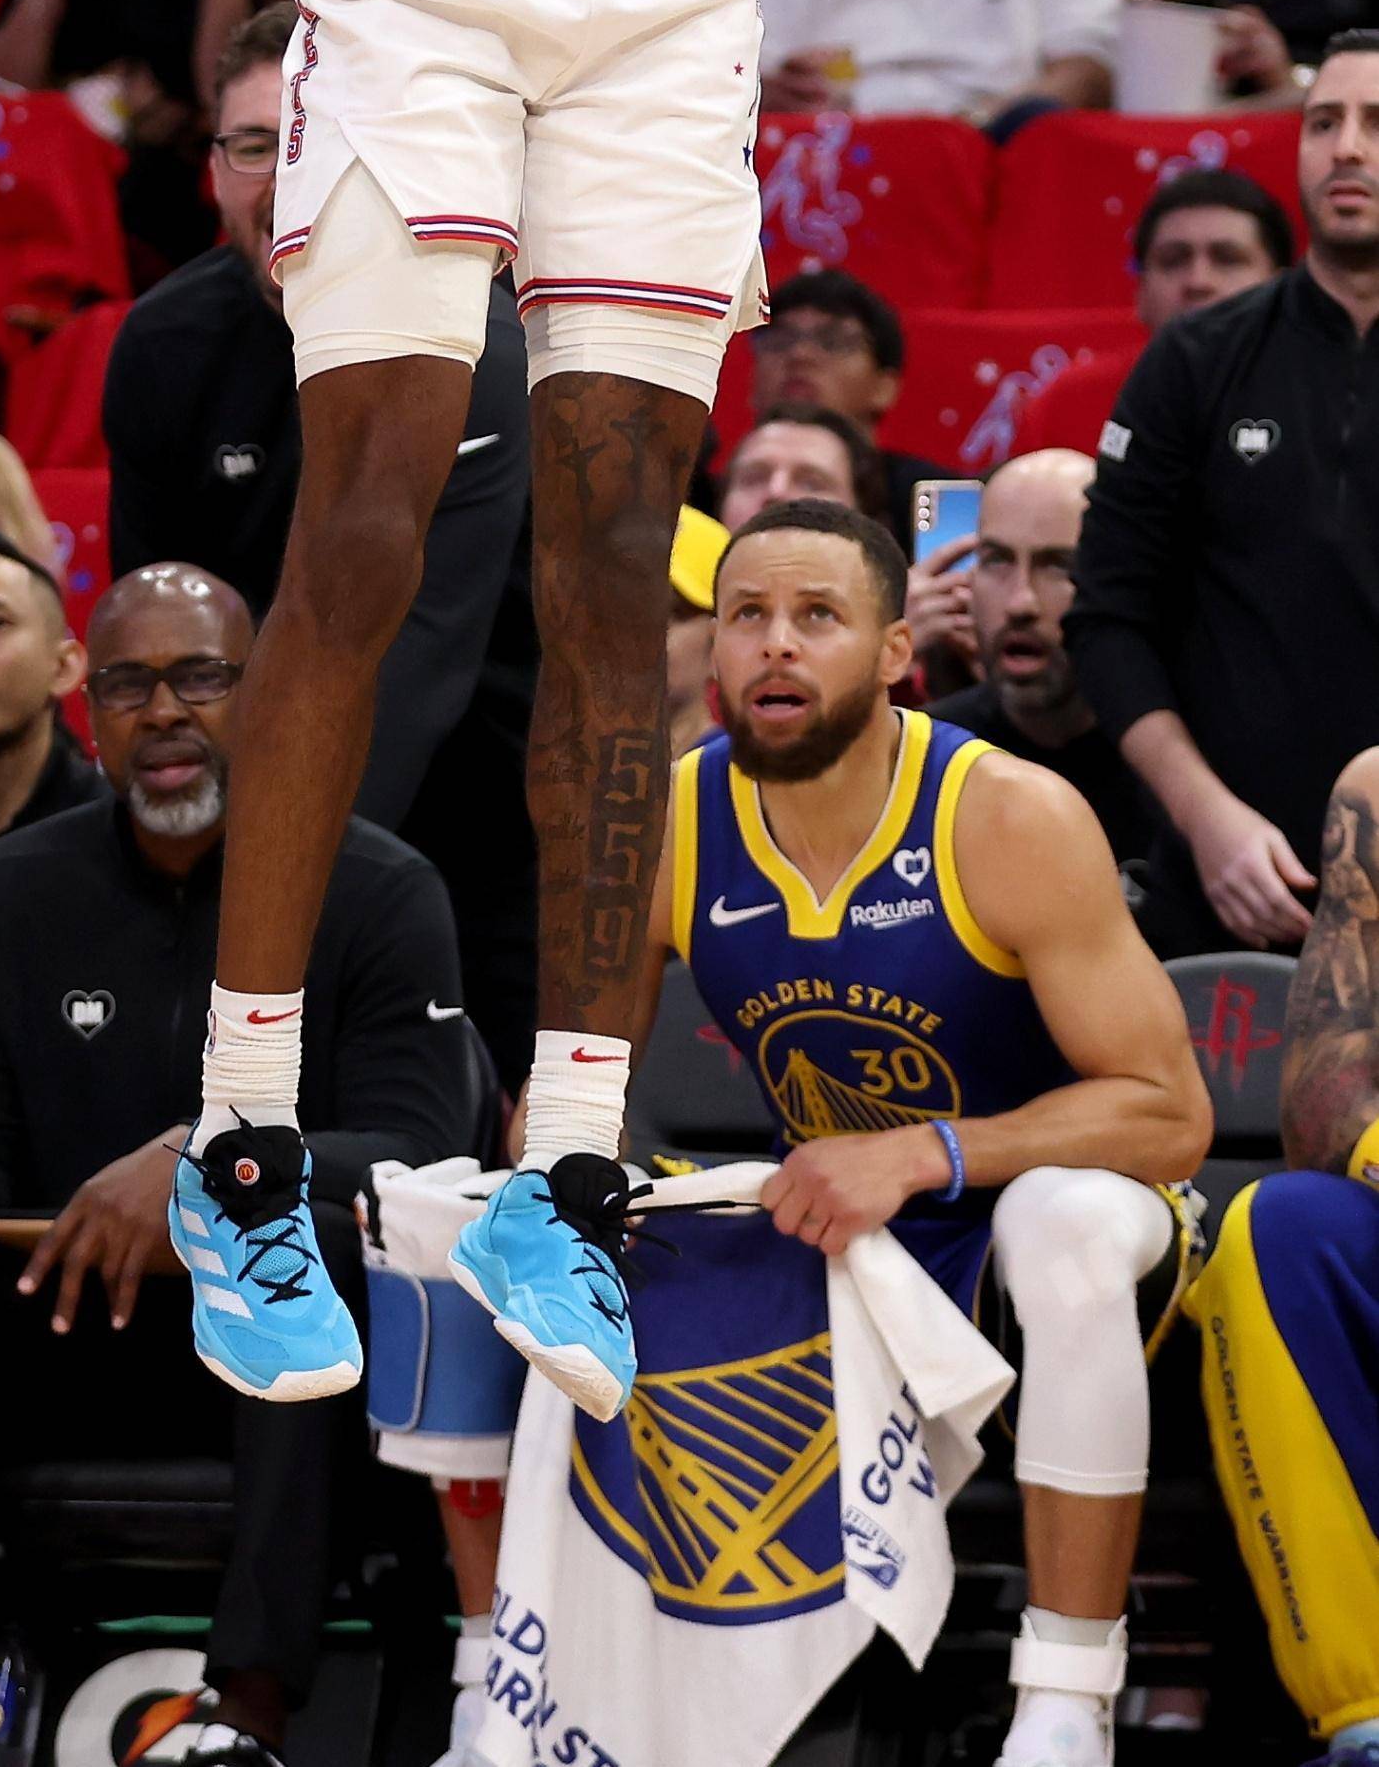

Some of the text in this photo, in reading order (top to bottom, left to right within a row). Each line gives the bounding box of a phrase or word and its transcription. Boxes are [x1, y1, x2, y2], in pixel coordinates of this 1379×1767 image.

[850, 897, 935, 928] Rakuten
[736, 977, 943, 1034] GOLDEN STATE
[851, 1045, 932, 1098] 30
[860, 1380, 925, 1505] GOL
